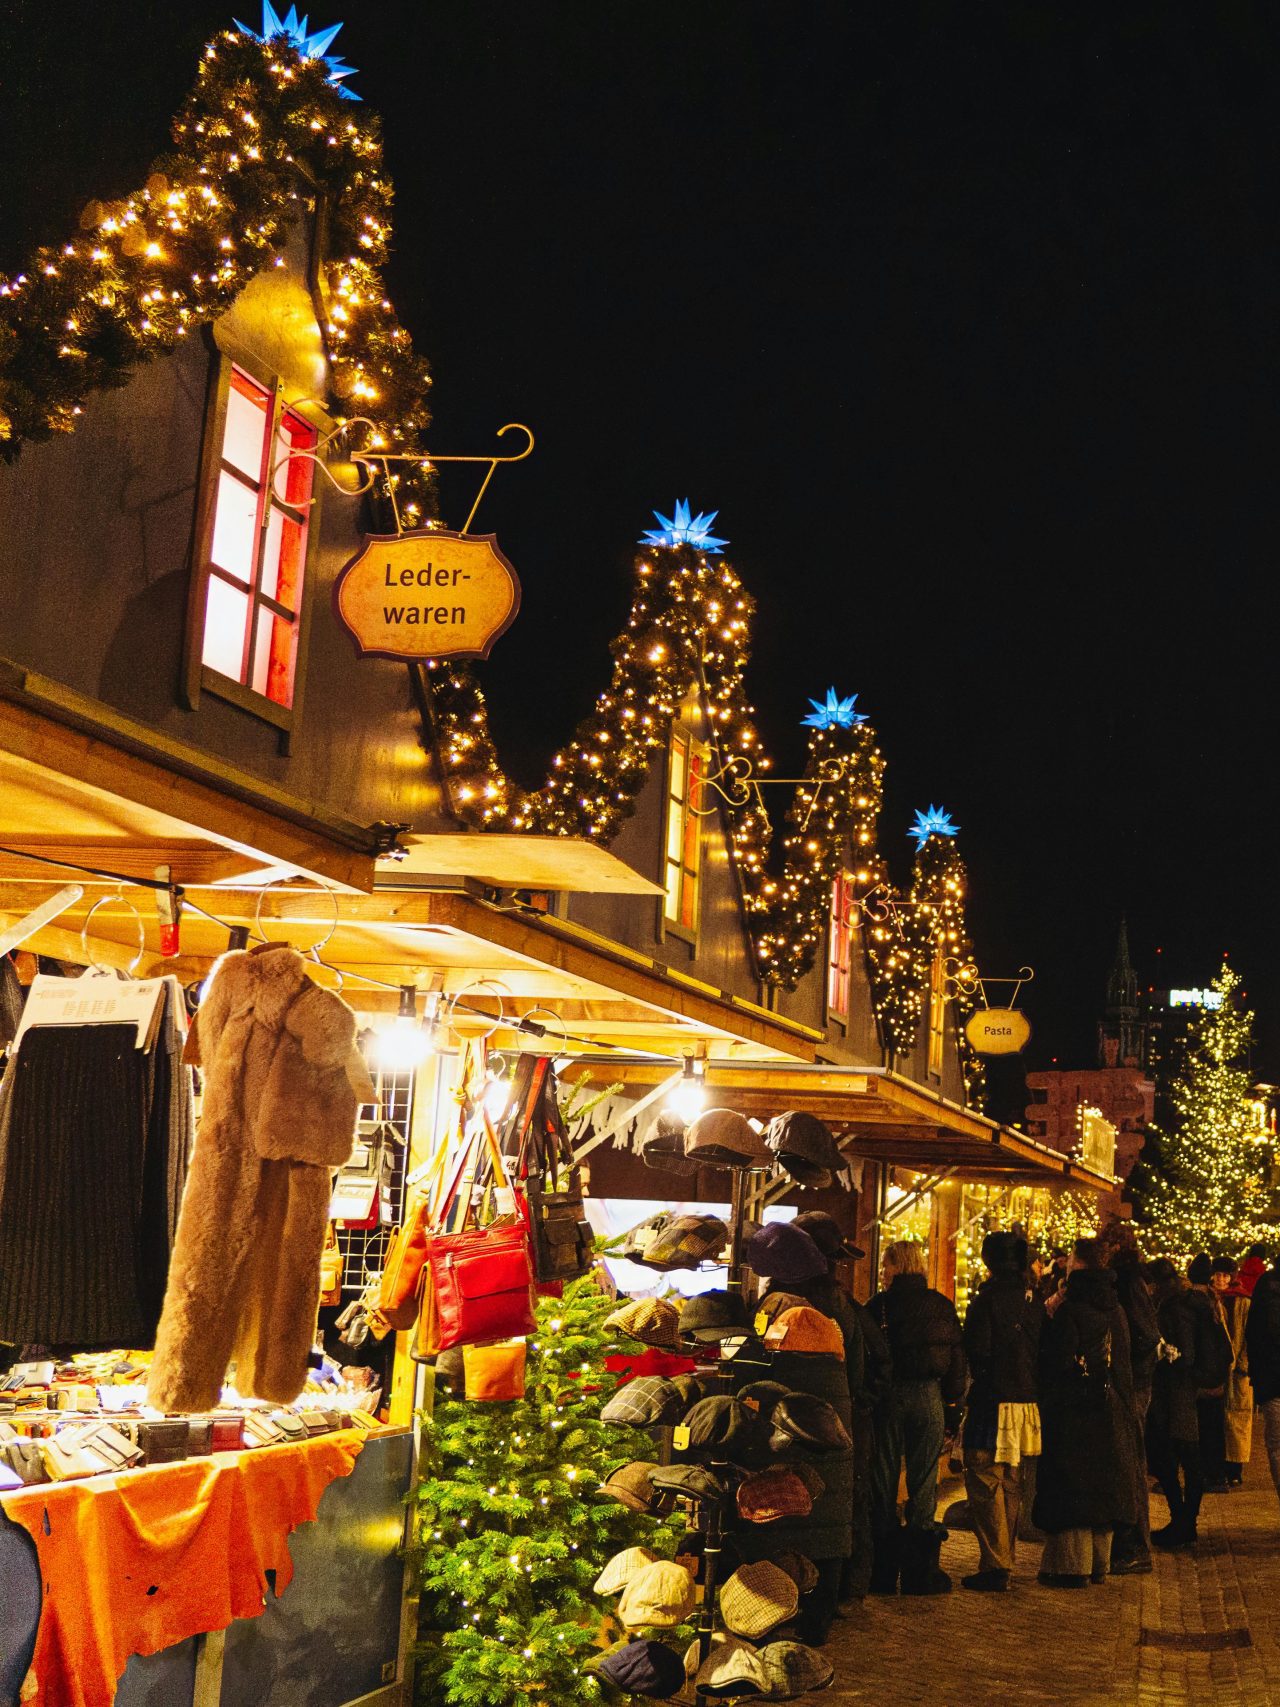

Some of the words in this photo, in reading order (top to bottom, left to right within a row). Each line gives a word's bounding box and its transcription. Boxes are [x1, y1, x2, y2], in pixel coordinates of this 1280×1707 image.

[384, 562, 471, 587] Leder-
[383, 606, 466, 625] waren
[984, 1026, 1012, 1035] Pasta
